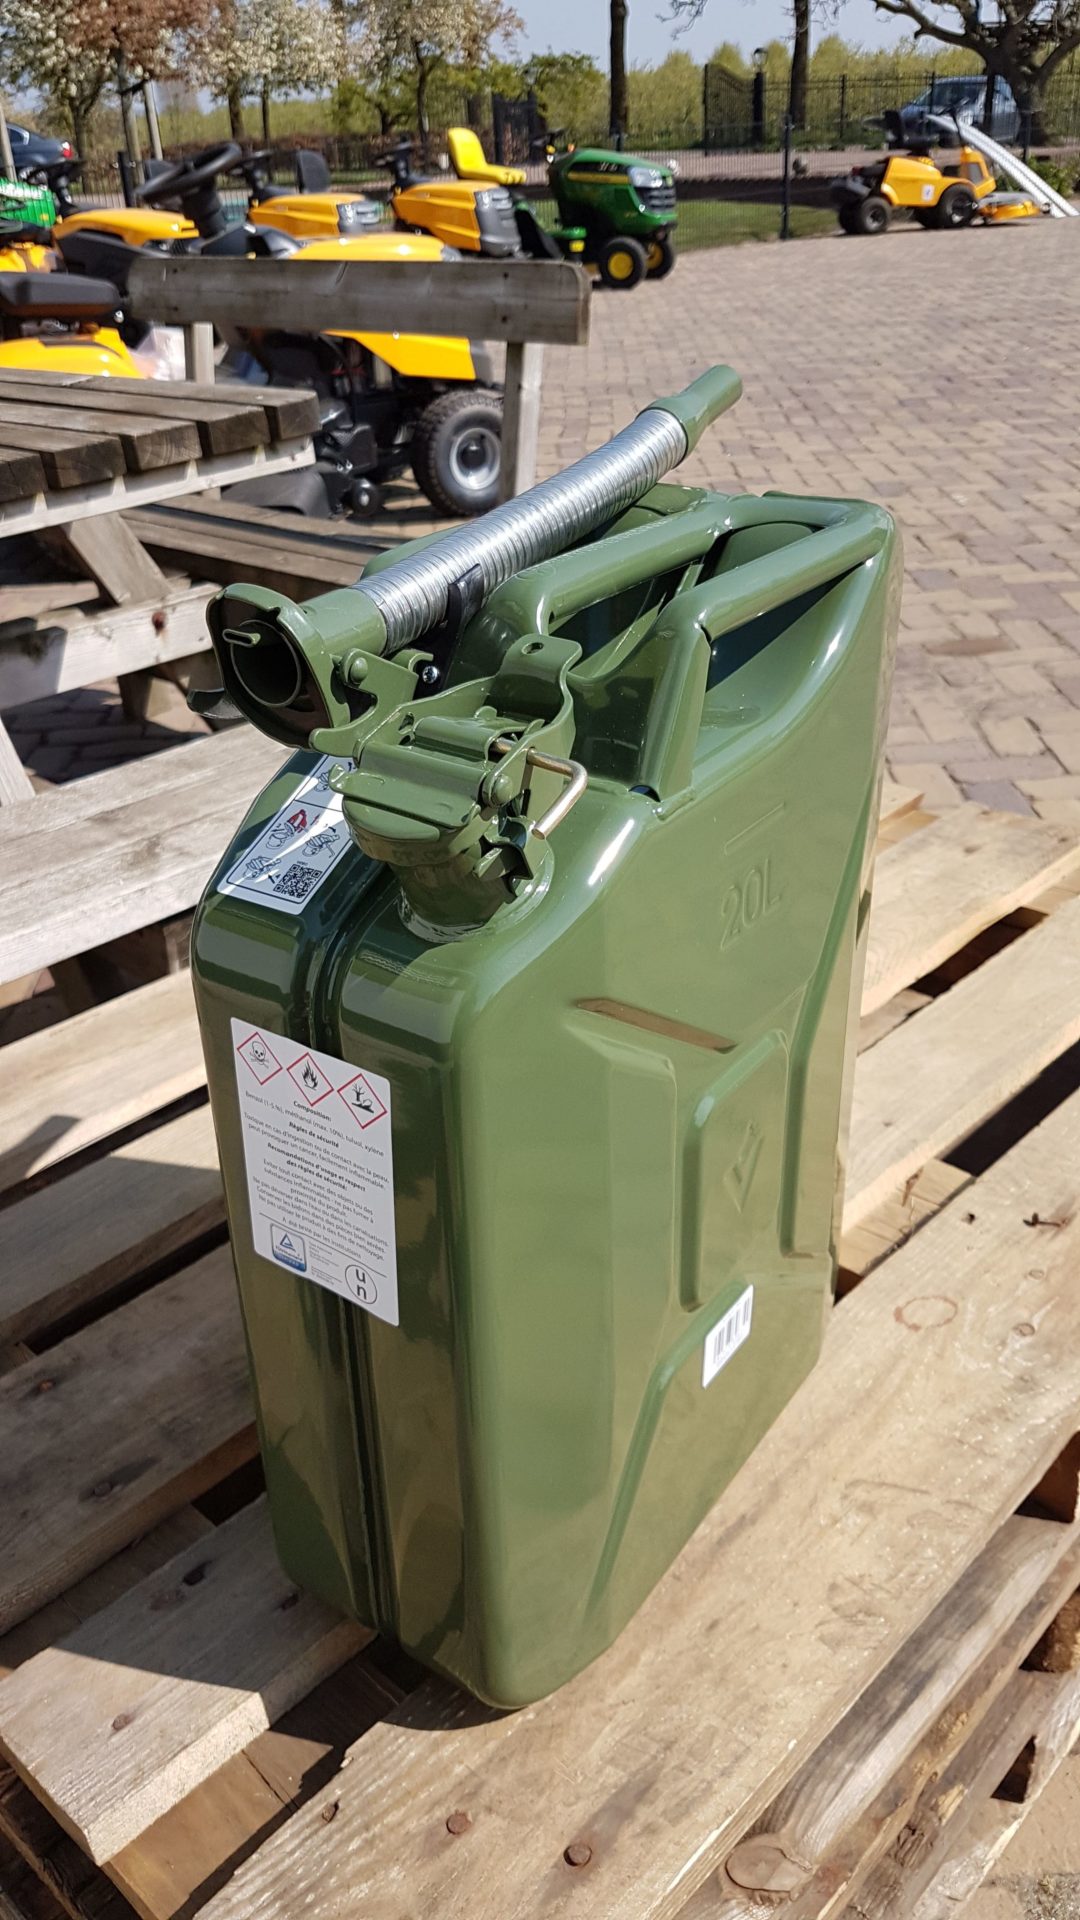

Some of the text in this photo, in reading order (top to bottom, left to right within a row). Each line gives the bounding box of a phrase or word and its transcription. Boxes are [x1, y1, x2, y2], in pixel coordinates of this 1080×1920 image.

[720, 858, 782, 951] 20L
[289, 1121, 307, 1134] Règles
[317, 1135, 339, 1148] sécurité
